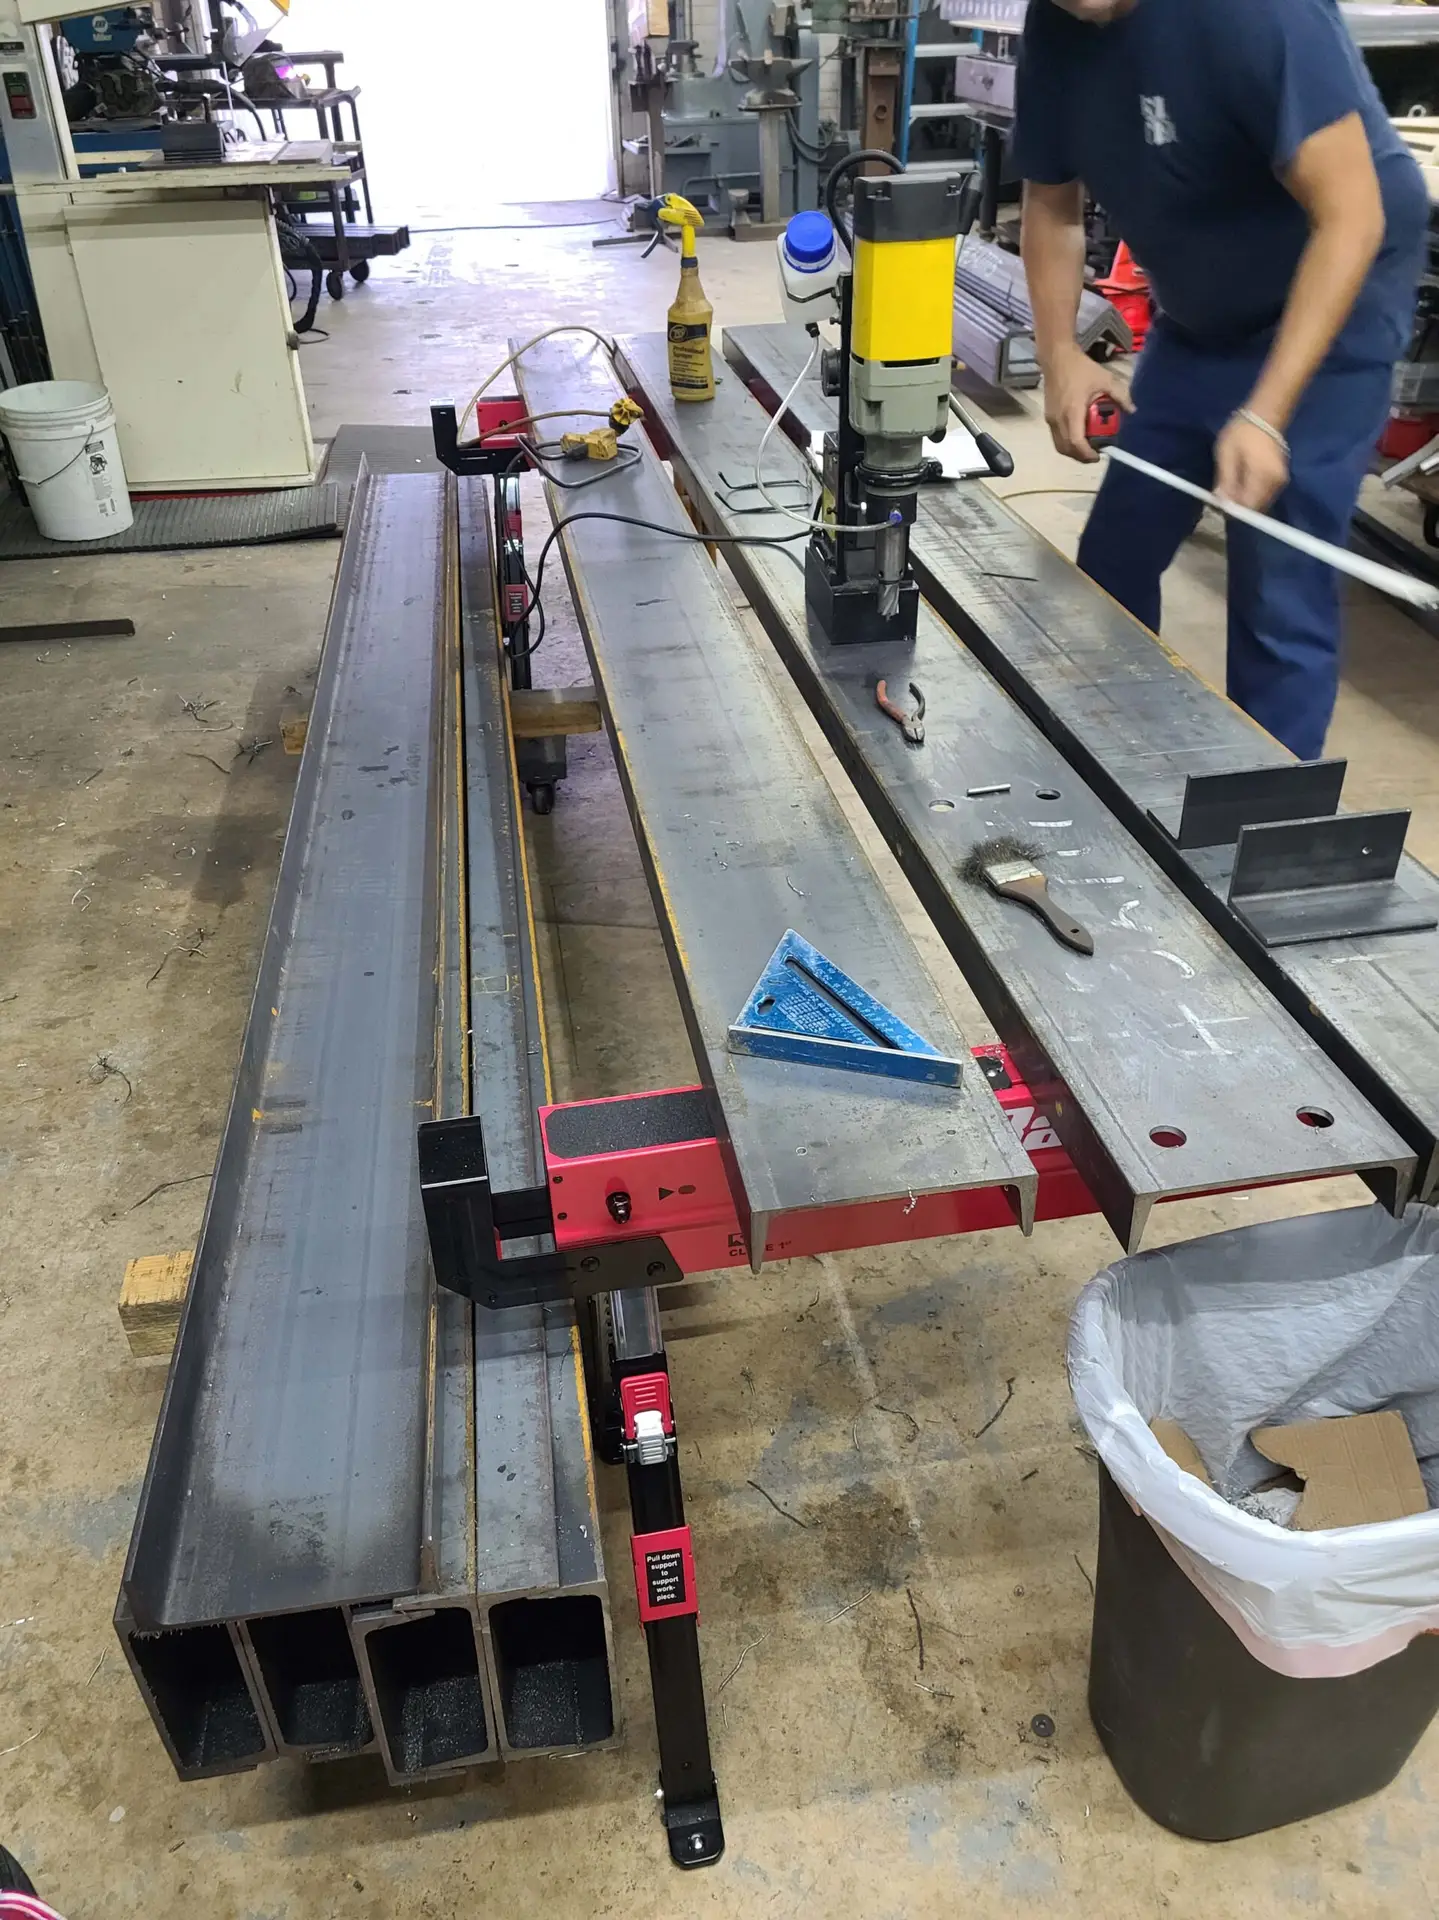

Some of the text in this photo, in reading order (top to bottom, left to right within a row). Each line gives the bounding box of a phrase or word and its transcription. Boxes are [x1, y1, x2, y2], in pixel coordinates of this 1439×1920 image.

[729, 1244, 774, 1256] CLE
[651, 1560, 677, 1570] support
[652, 1576, 679, 1586] support
[656, 1585, 676, 1593] work-
[656, 1593, 677, 1602] piece.
